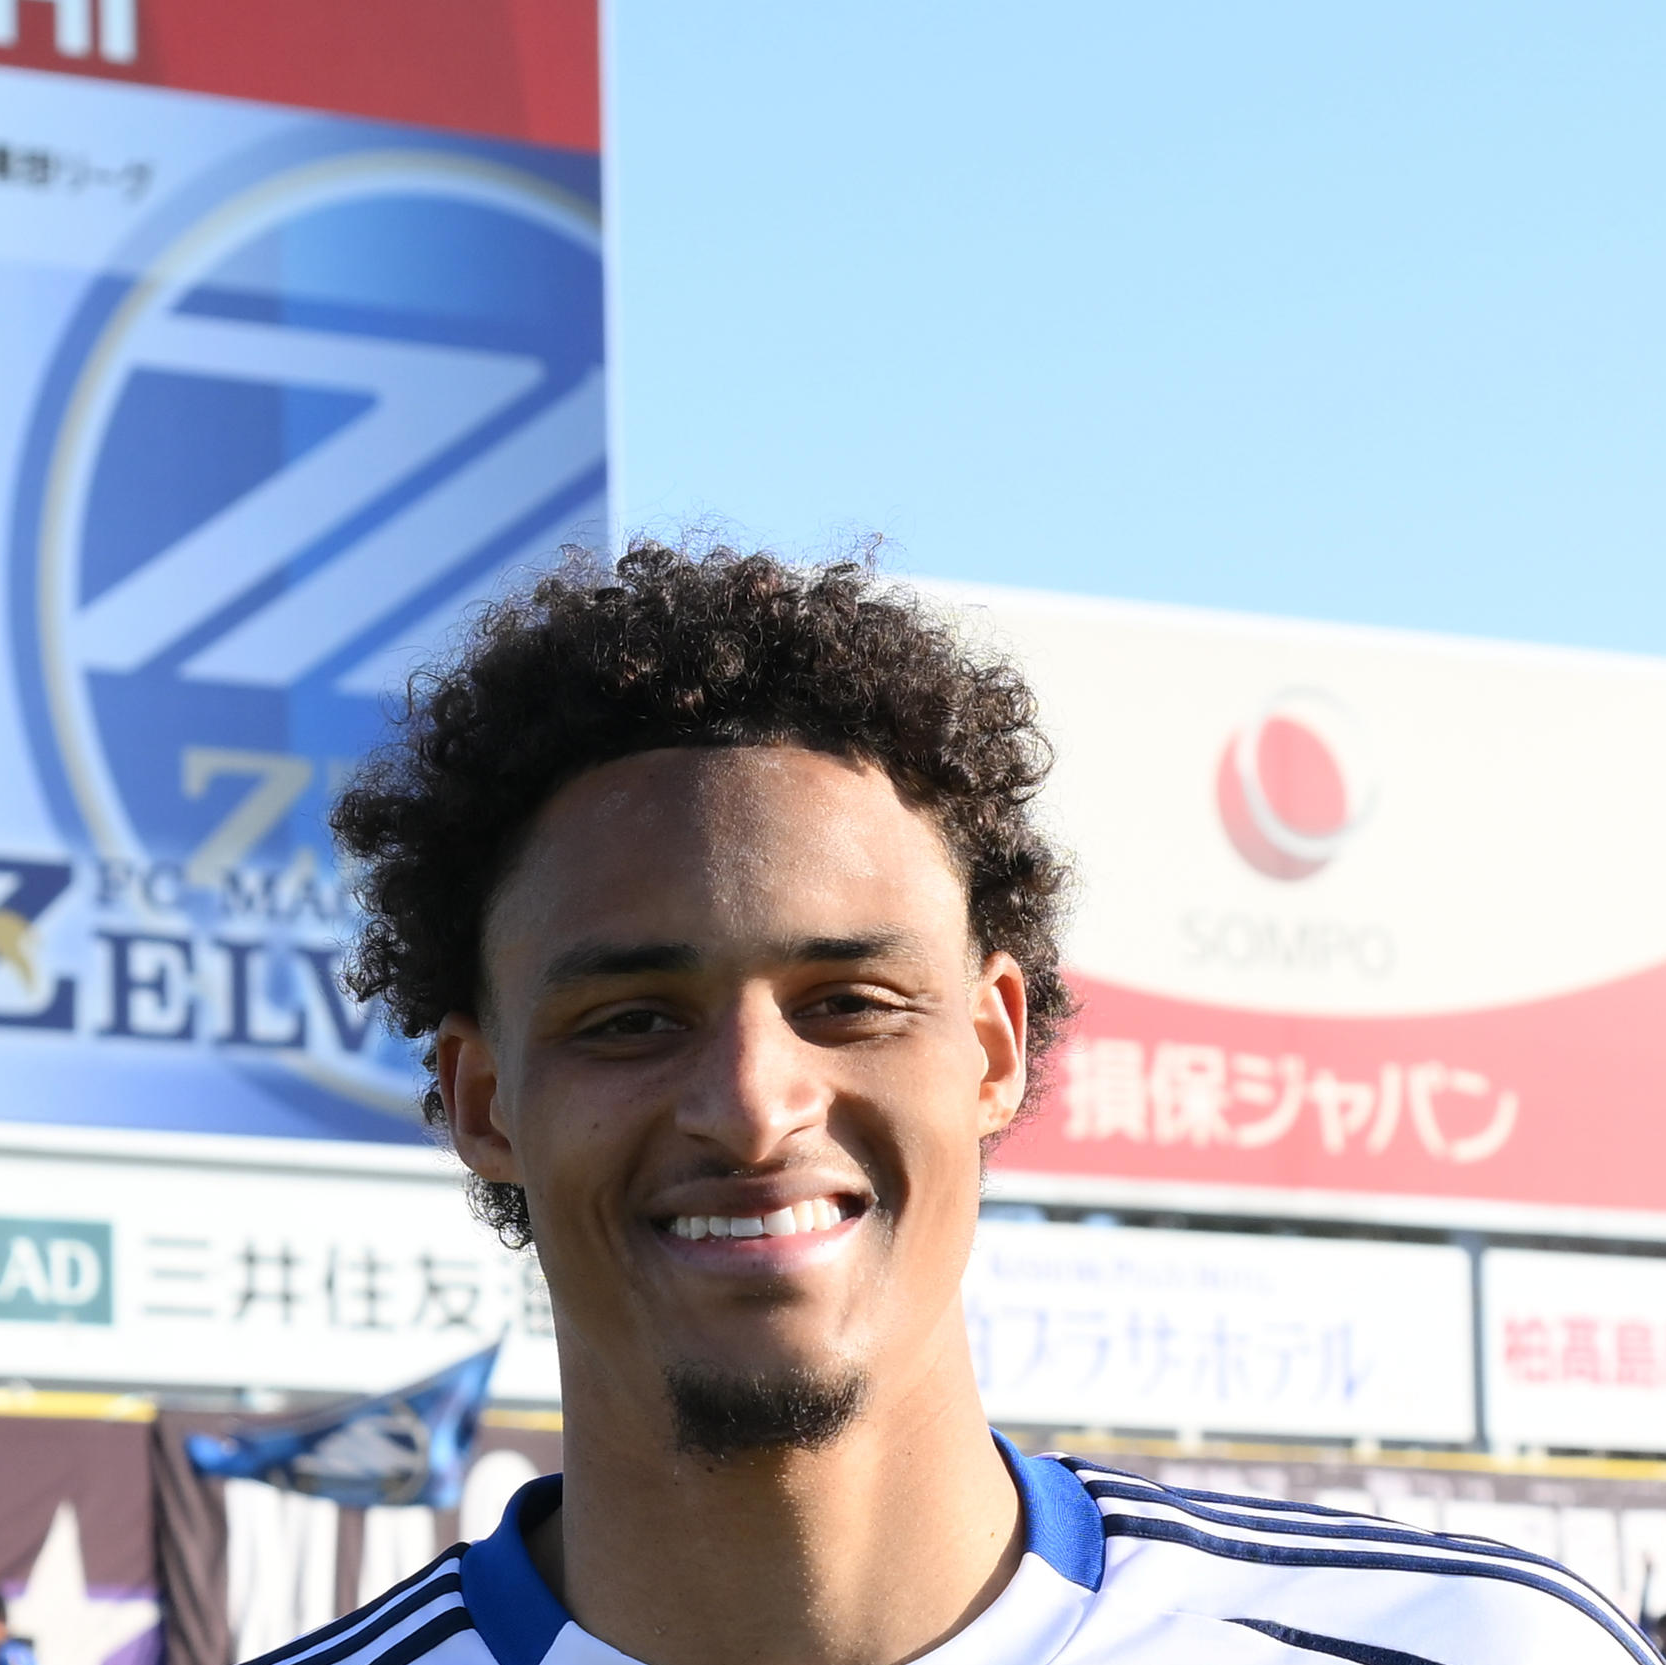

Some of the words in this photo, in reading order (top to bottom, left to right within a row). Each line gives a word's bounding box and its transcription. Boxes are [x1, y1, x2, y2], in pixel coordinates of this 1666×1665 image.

[1178, 908, 1399, 980] SOMPO
[1063, 1038, 1519, 1162] 損保ジャパン
